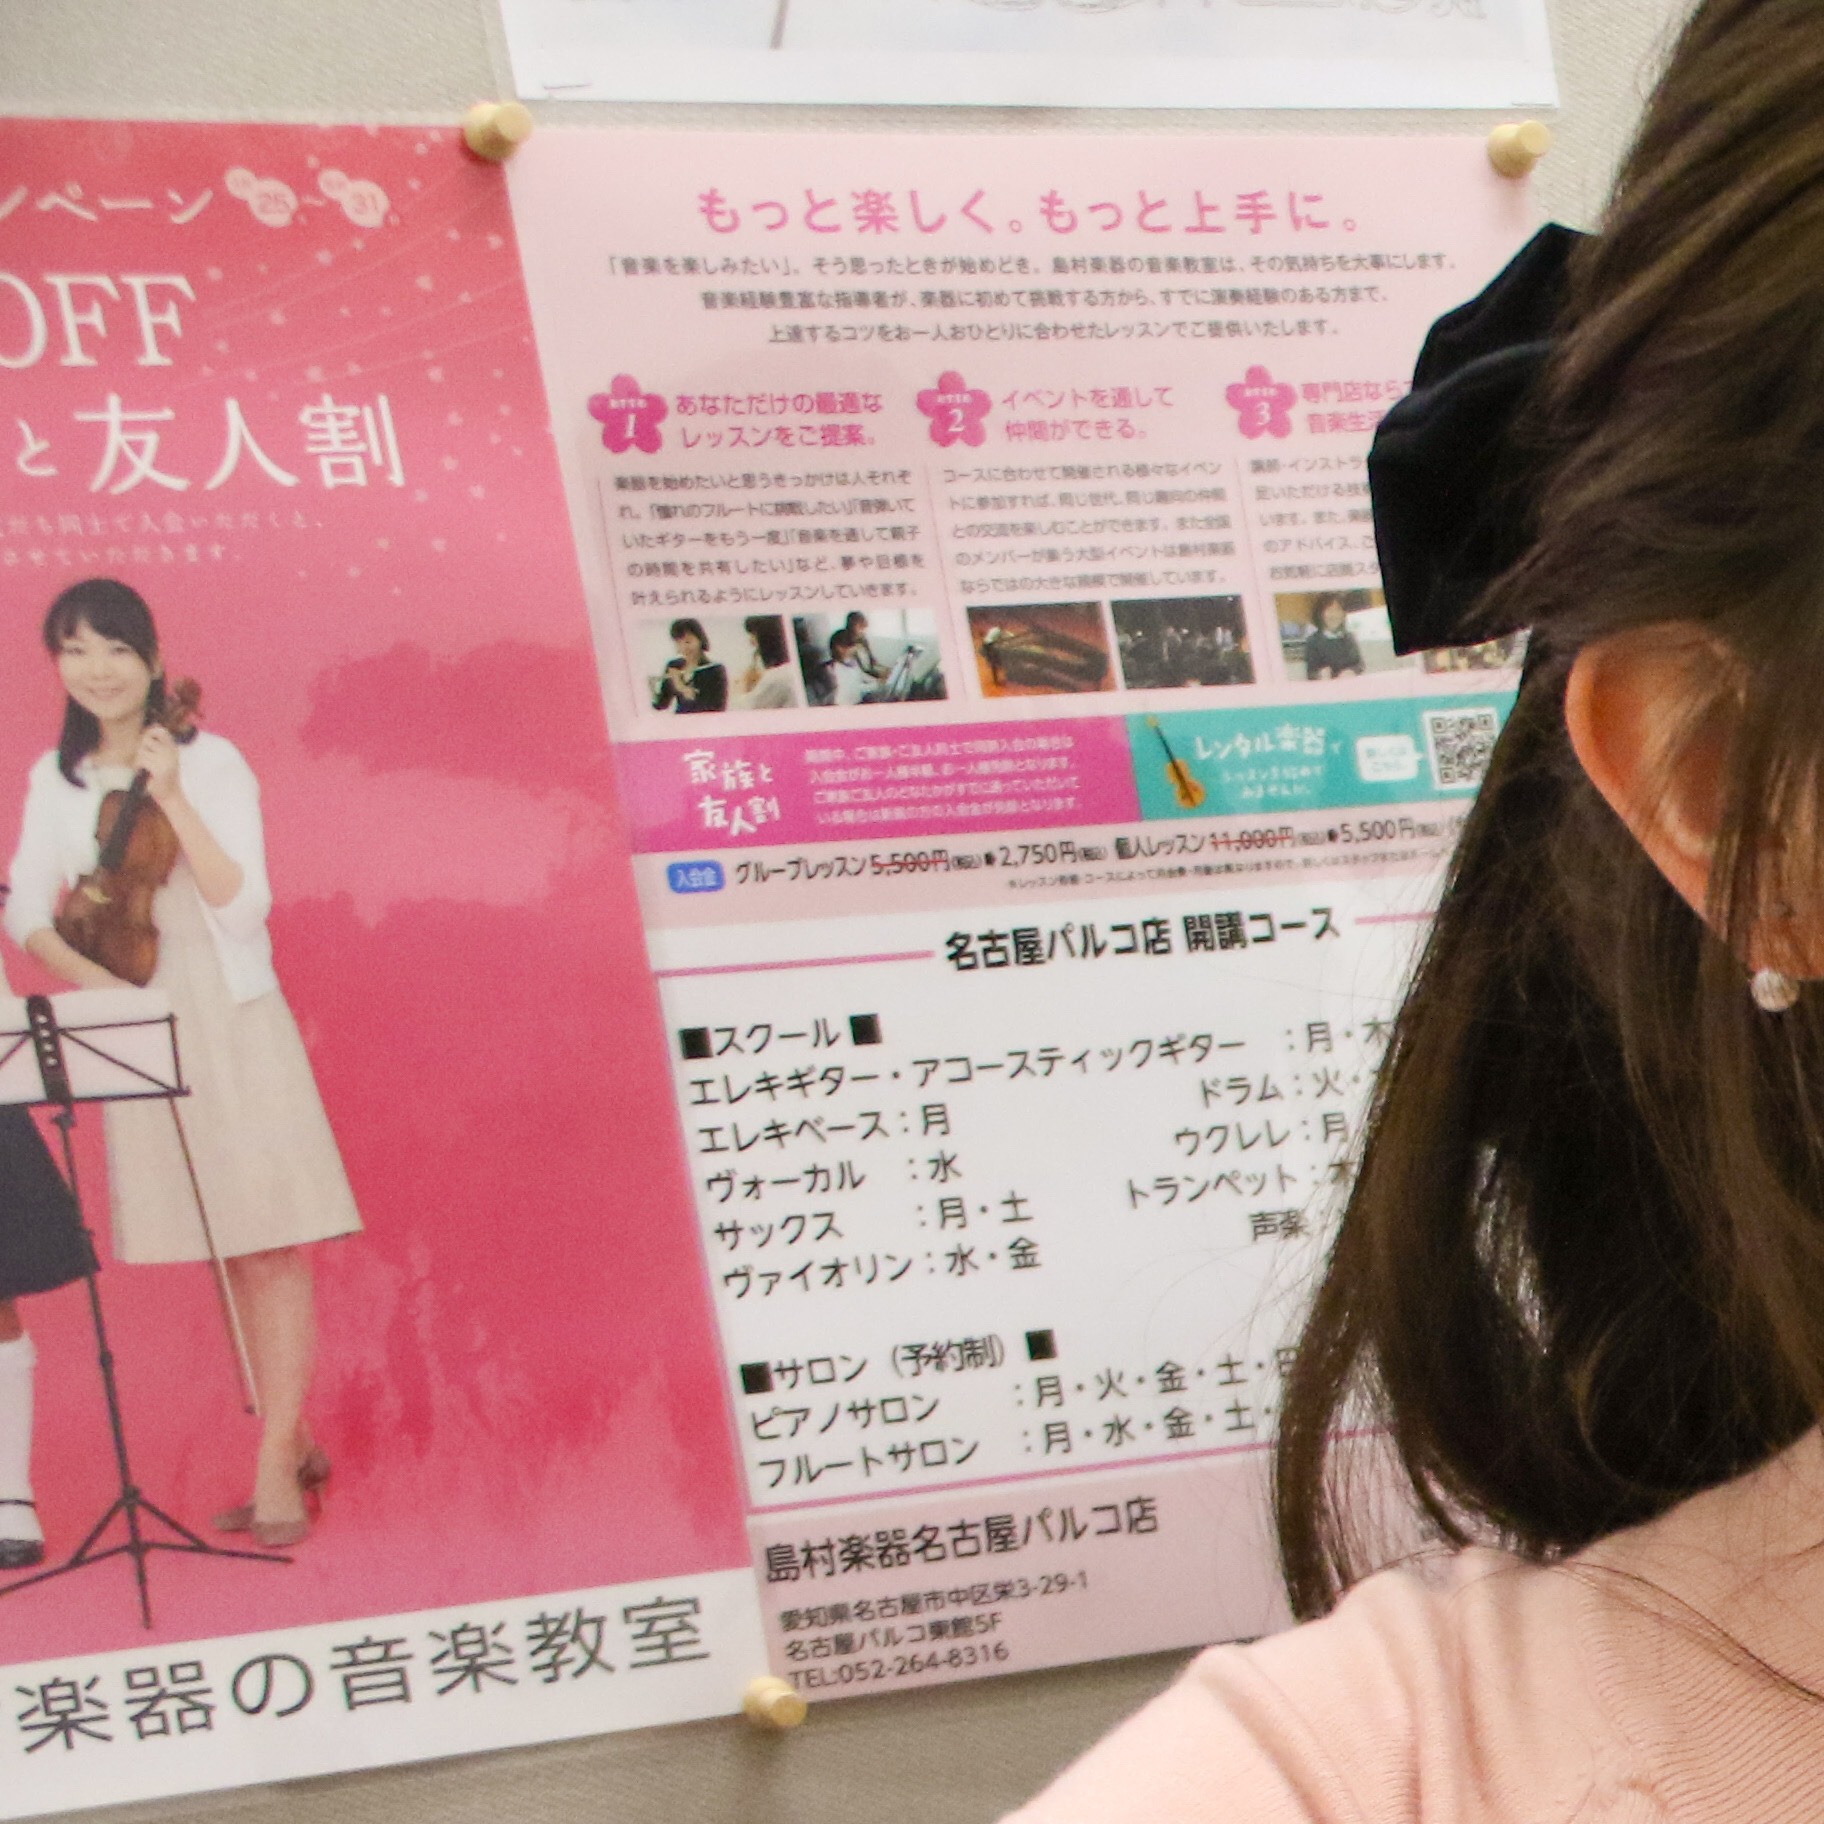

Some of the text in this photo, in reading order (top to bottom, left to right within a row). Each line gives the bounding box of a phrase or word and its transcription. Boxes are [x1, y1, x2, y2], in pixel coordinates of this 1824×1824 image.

[699, 188, 1358, 234] もっと楽しく。もっと上手に。
[1002, 385, 1174, 410] イベントを通して
[1256, 402, 1271, 425] 3
[1301, 379, 1412, 404] 専門店なら
[948, 408, 965, 432] 2
[1005, 419, 1147, 442] 仲間ができる。
[17, 393, 405, 495] と友人割
[682, 748, 774, 791] 家族と
[698, 795, 781, 837] 友人割
[945, 906, 1341, 971] 名古屋パルコ店 開講コース
[689, 1033, 1247, 1107] エレキギター・アコースティックギター
[705, 1159, 867, 1204] ヴォーカル
[713, 1211, 845, 1252] サックス
[750, 1393, 941, 1442] ピアノサロン
[757, 1434, 980, 1490] フルートサロン
[765, 1495, 1160, 1583] 島村楽器名古屋パルコ店
[779, 1569, 1089, 1633] 愛知県名古屋市中区栄3-29-1
[15, 1595, 711, 1754] 楽器の音楽教室
